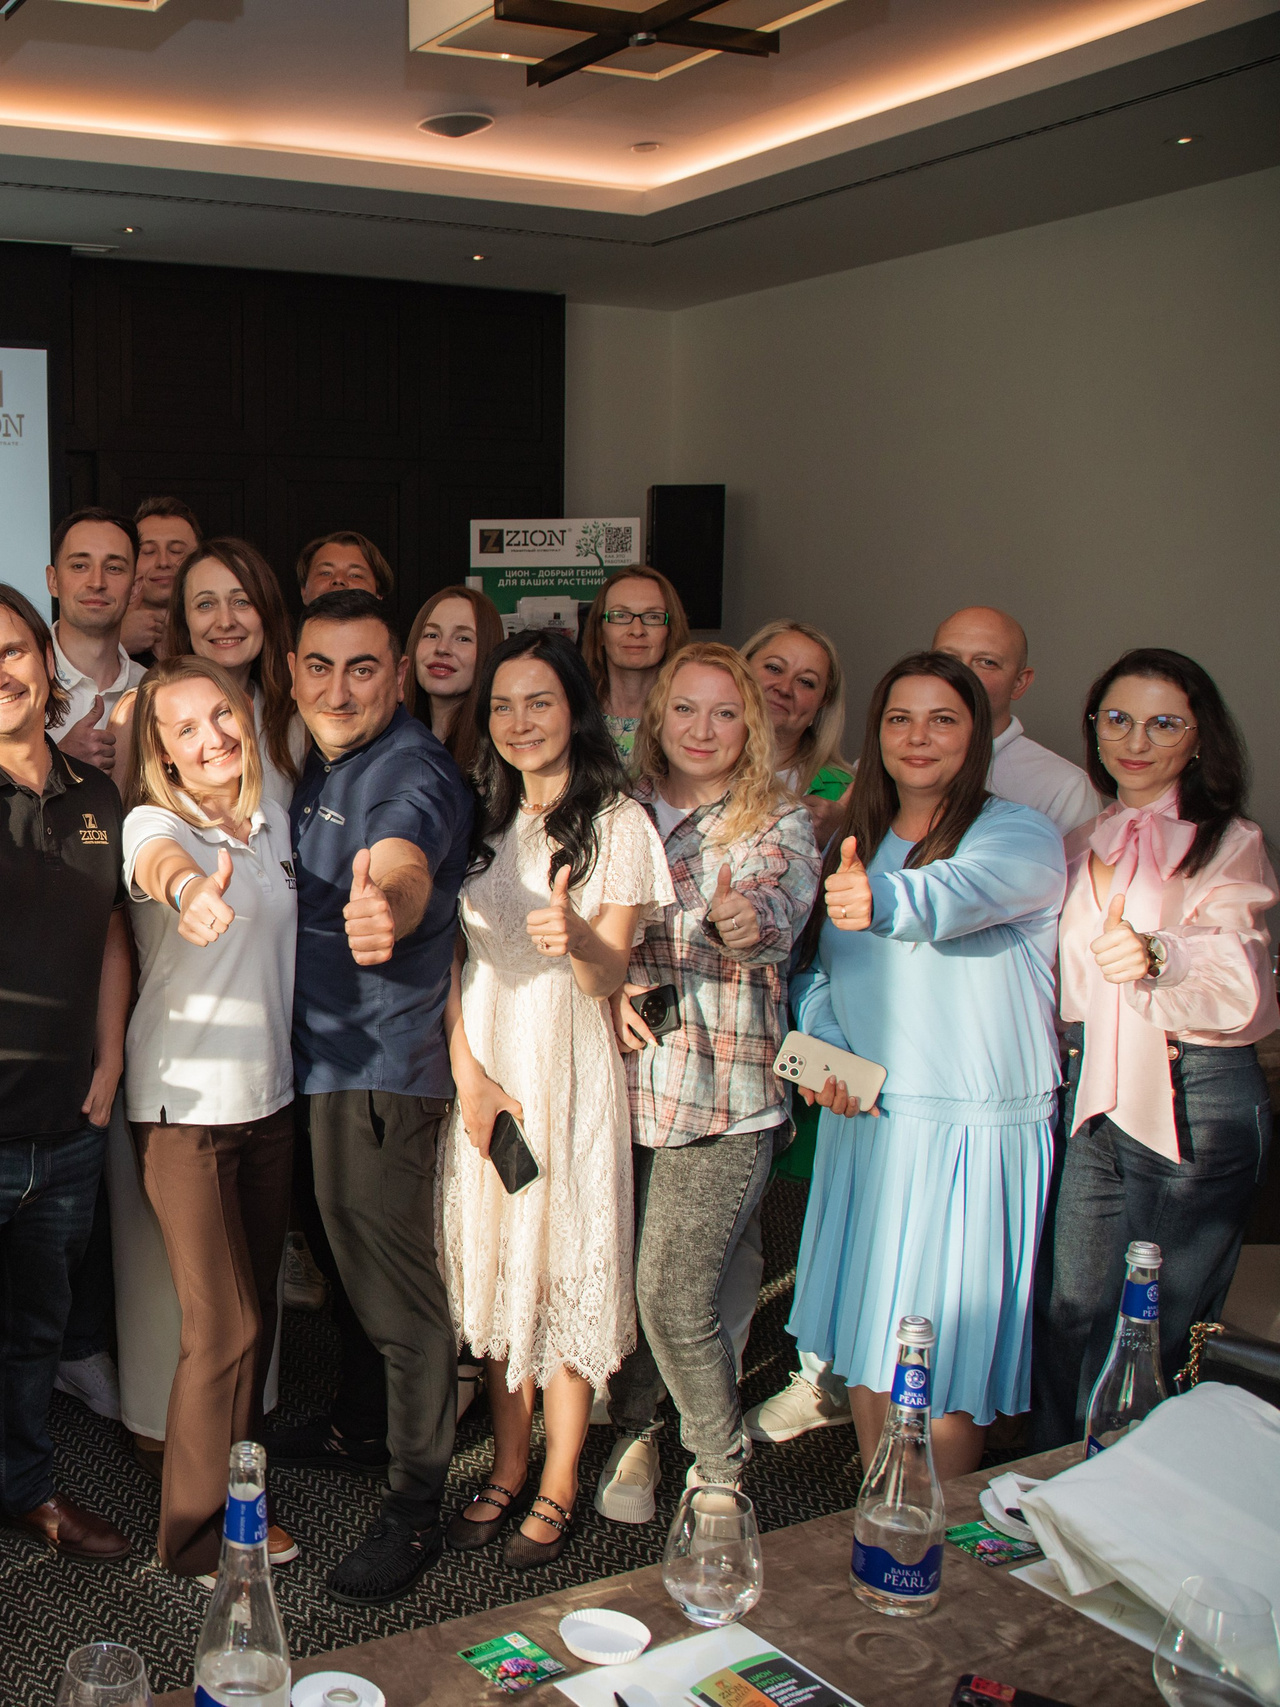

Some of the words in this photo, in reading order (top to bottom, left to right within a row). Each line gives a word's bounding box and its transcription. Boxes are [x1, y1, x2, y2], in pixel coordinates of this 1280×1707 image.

[506, 530, 566, 546] ZION
[505, 570, 530, 578] ЦИОН
[538, 568, 575, 578] ДОБРЫЙ
[577, 568, 604, 577] ГЕНИЙ
[498, 579, 518, 587] ДЛЯ
[521, 578, 556, 586] ВАШИХ
[558, 577, 607, 586] РАСТЕНИЙ
[79, 830, 108, 841] ZION
[899, 1393, 927, 1406] PEARL
[891, 1567, 921, 1577] BAIKAL
[883, 1572, 926, 1588] PEARL
[747, 1669, 773, 1683] ЦИОН
[755, 1672, 791, 1689] ПРОТЕКТ
